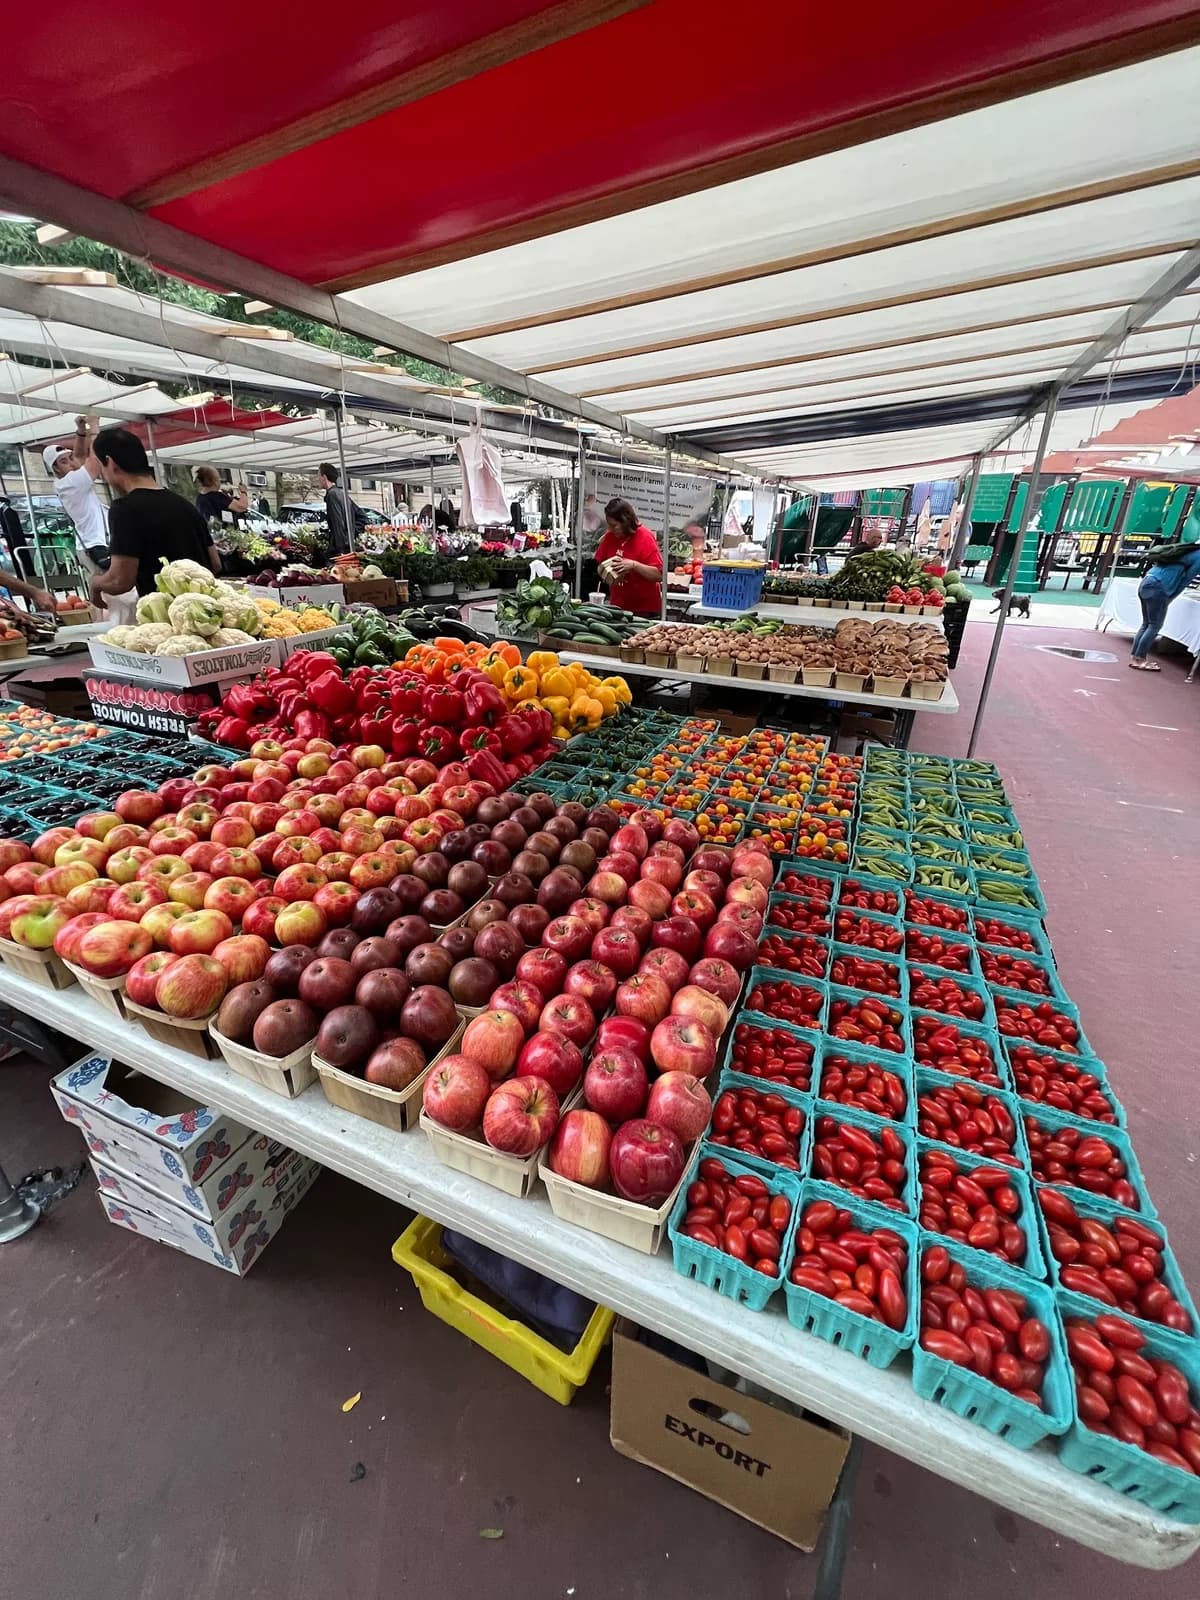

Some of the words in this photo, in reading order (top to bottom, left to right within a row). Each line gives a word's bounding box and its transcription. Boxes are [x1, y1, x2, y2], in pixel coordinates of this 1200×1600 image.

[591, 469, 602, 479] Sx
[193, 652, 246, 677] TOMATOES
[91, 702, 146, 728] TOMATOES
[148, 715, 186, 734] FRESH
[664, 1413, 772, 1478] EXPORT
